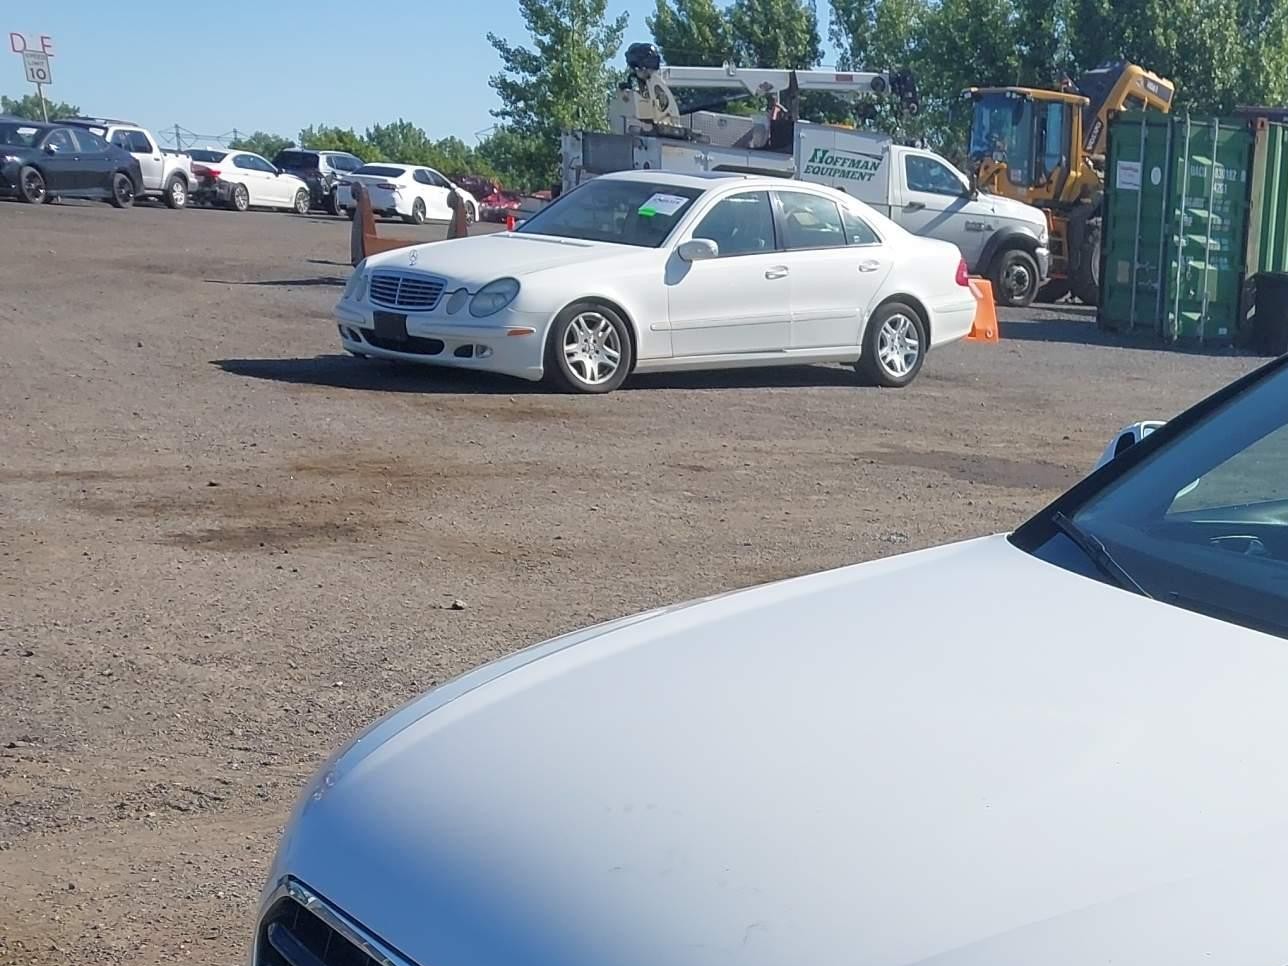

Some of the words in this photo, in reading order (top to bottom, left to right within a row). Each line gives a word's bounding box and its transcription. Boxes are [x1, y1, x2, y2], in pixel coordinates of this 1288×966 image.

[30, 68, 46, 80] 10
[808, 147, 881, 172] HOFFMAN
[804, 164, 876, 182] EQUIPMENT
